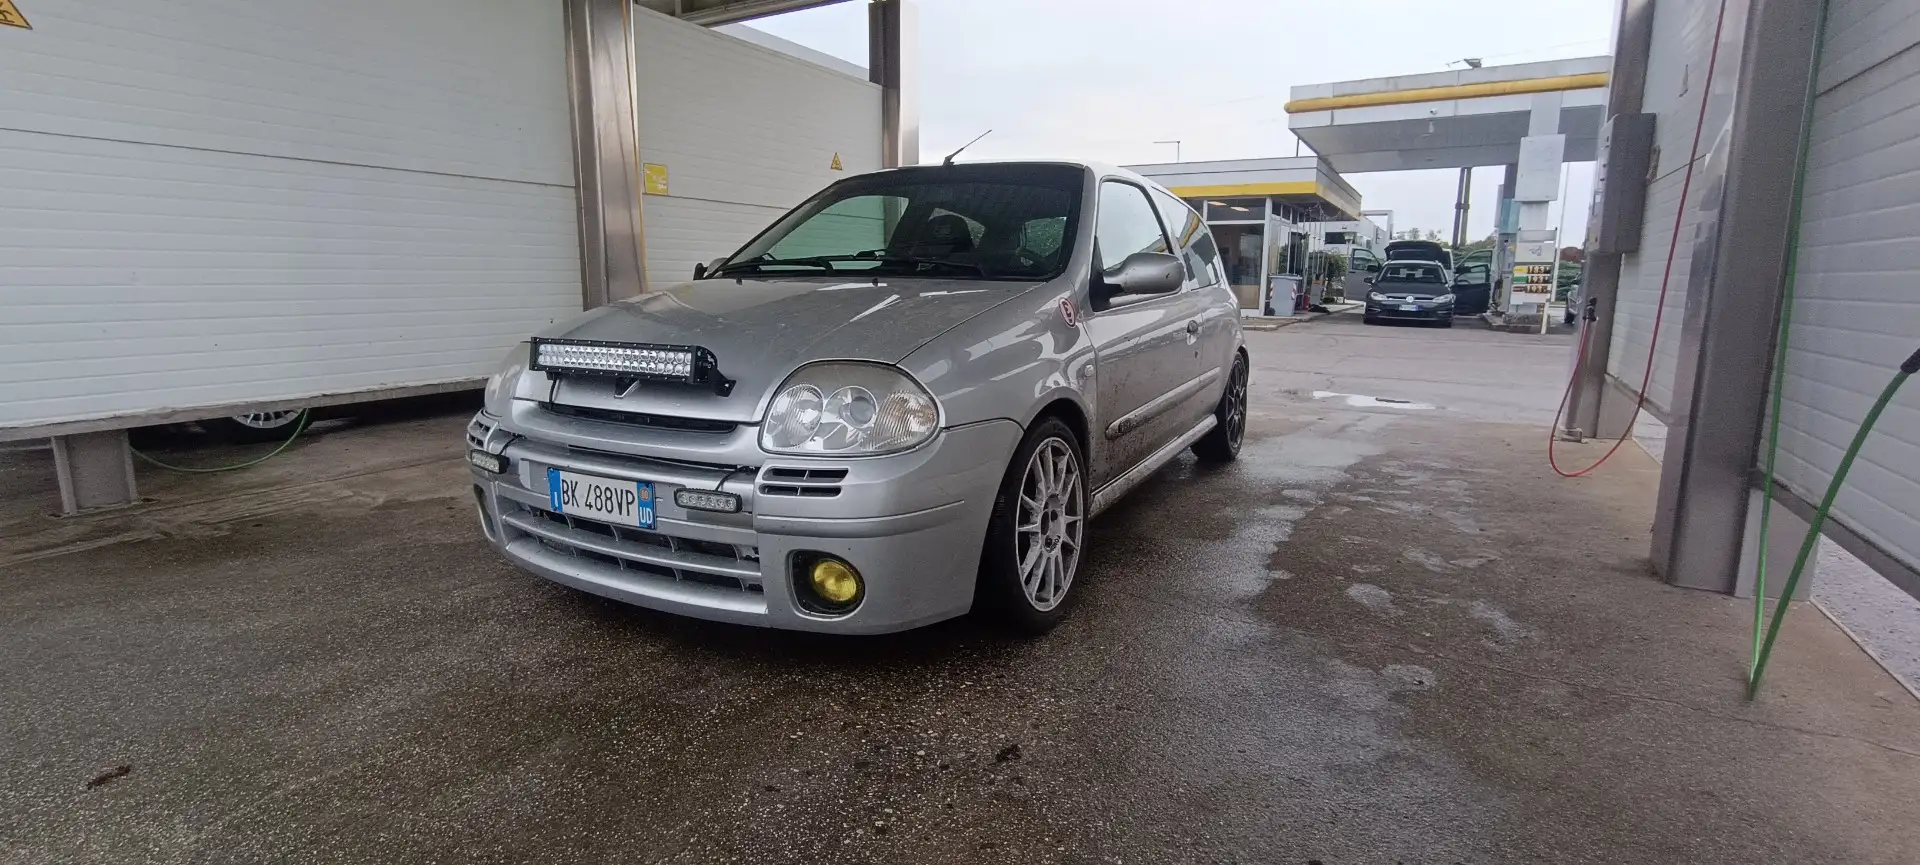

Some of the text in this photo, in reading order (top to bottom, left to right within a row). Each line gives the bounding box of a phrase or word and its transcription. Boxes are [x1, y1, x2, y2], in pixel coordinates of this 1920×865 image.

[562, 479, 635, 516] BK 488VP
[640, 507, 652, 524] UD
